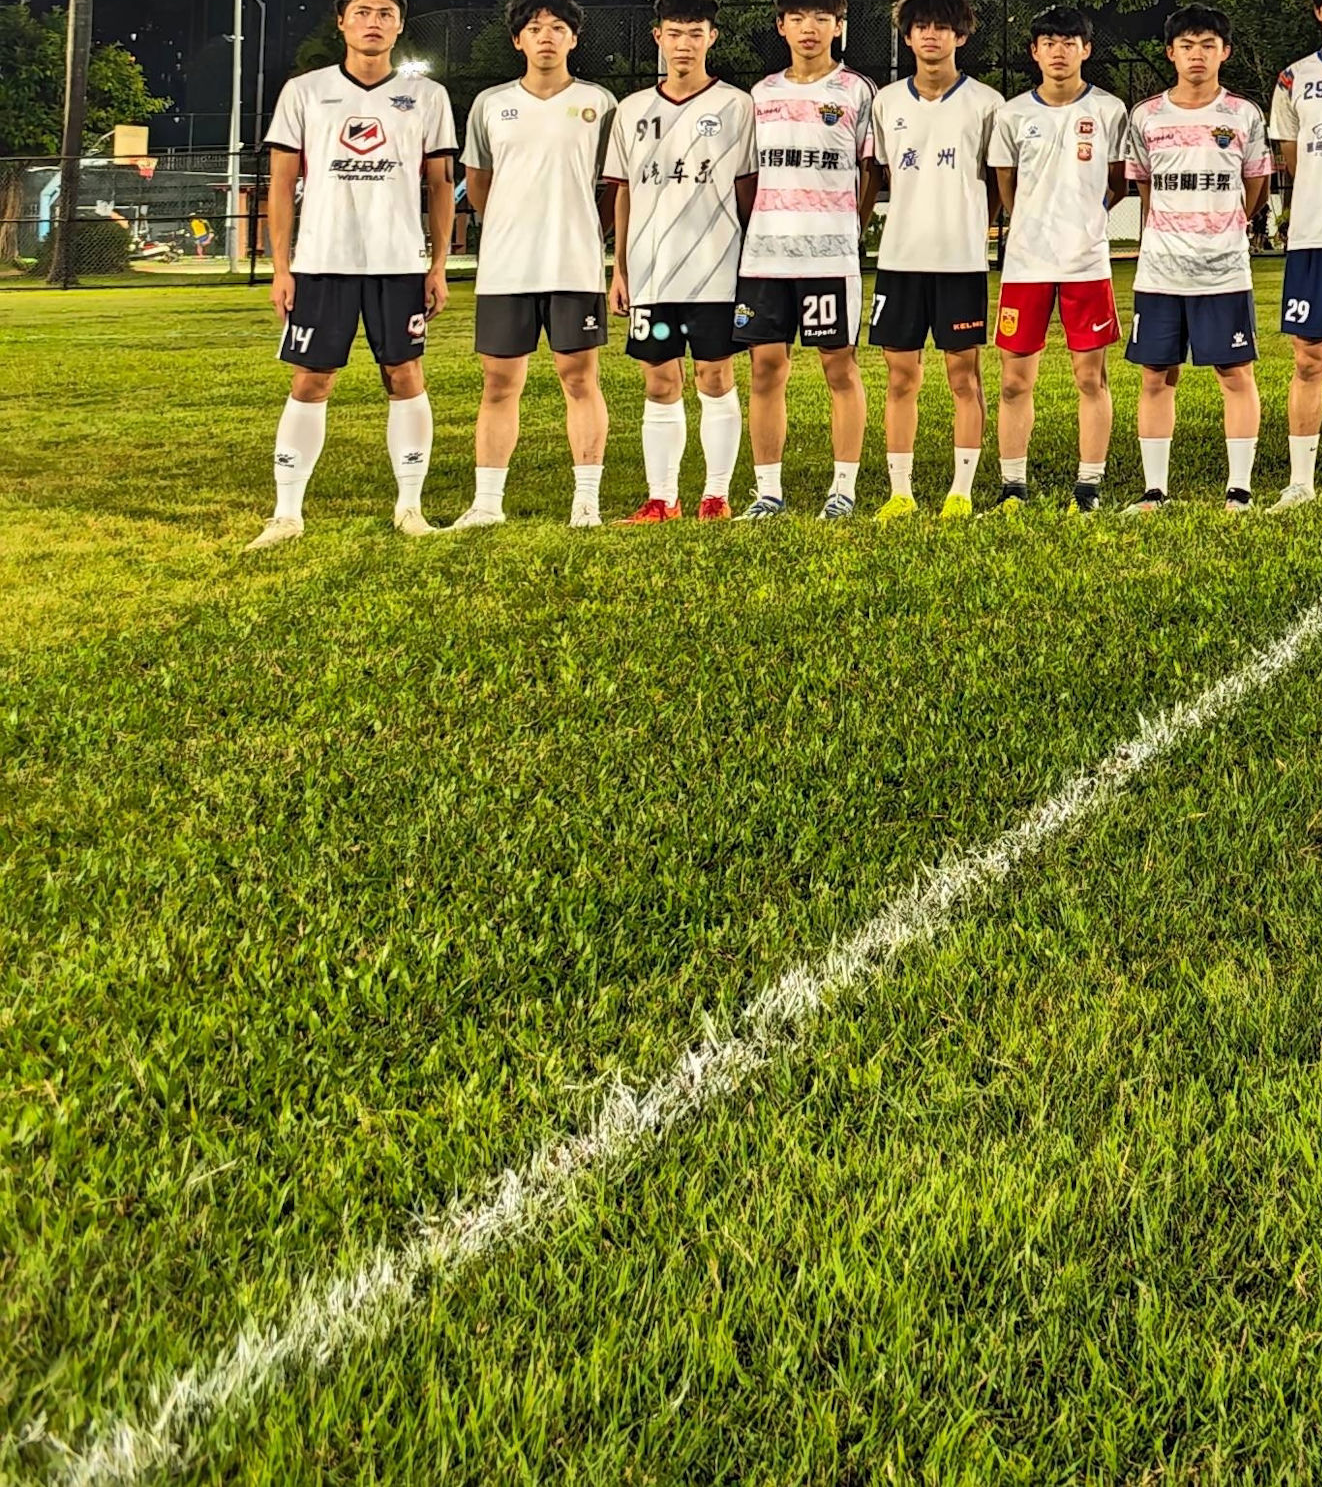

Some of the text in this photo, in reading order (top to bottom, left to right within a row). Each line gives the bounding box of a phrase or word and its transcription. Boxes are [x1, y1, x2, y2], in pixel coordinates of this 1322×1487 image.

[636, 116, 661, 141] 91
[803, 293, 837, 326] 20
[1285, 298, 1310, 324] 29
[290, 324, 315, 354] 14
